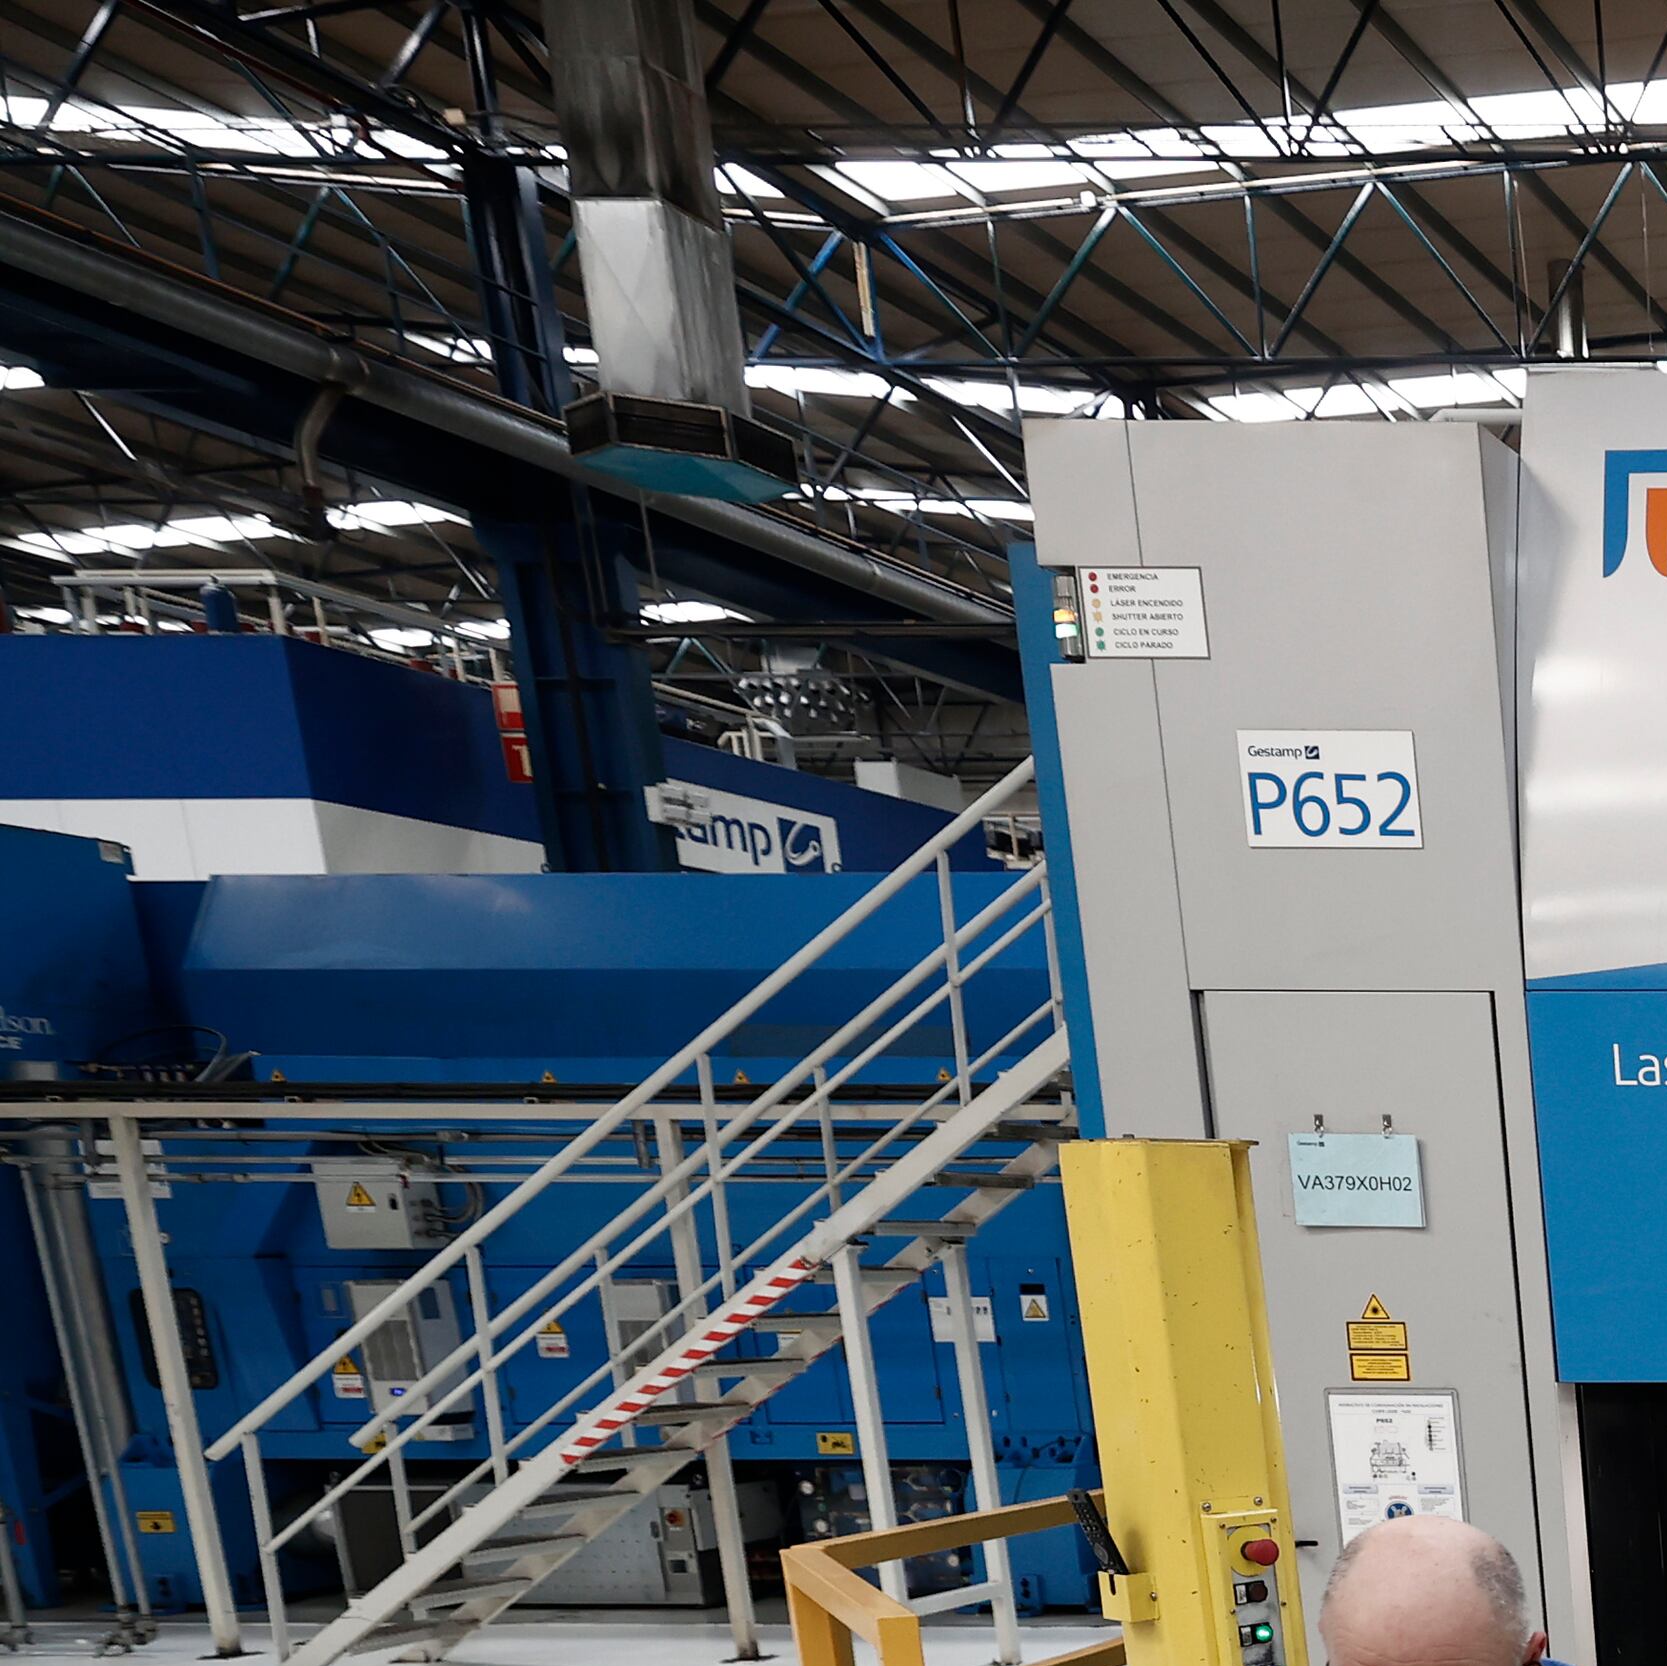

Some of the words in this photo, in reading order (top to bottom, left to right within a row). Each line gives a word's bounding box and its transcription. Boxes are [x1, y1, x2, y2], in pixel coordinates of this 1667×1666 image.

[1248, 745, 1302, 760] Gestamp
[1247, 771, 1416, 838] P652
[1297, 1174, 1412, 1192] VA379X0H02
